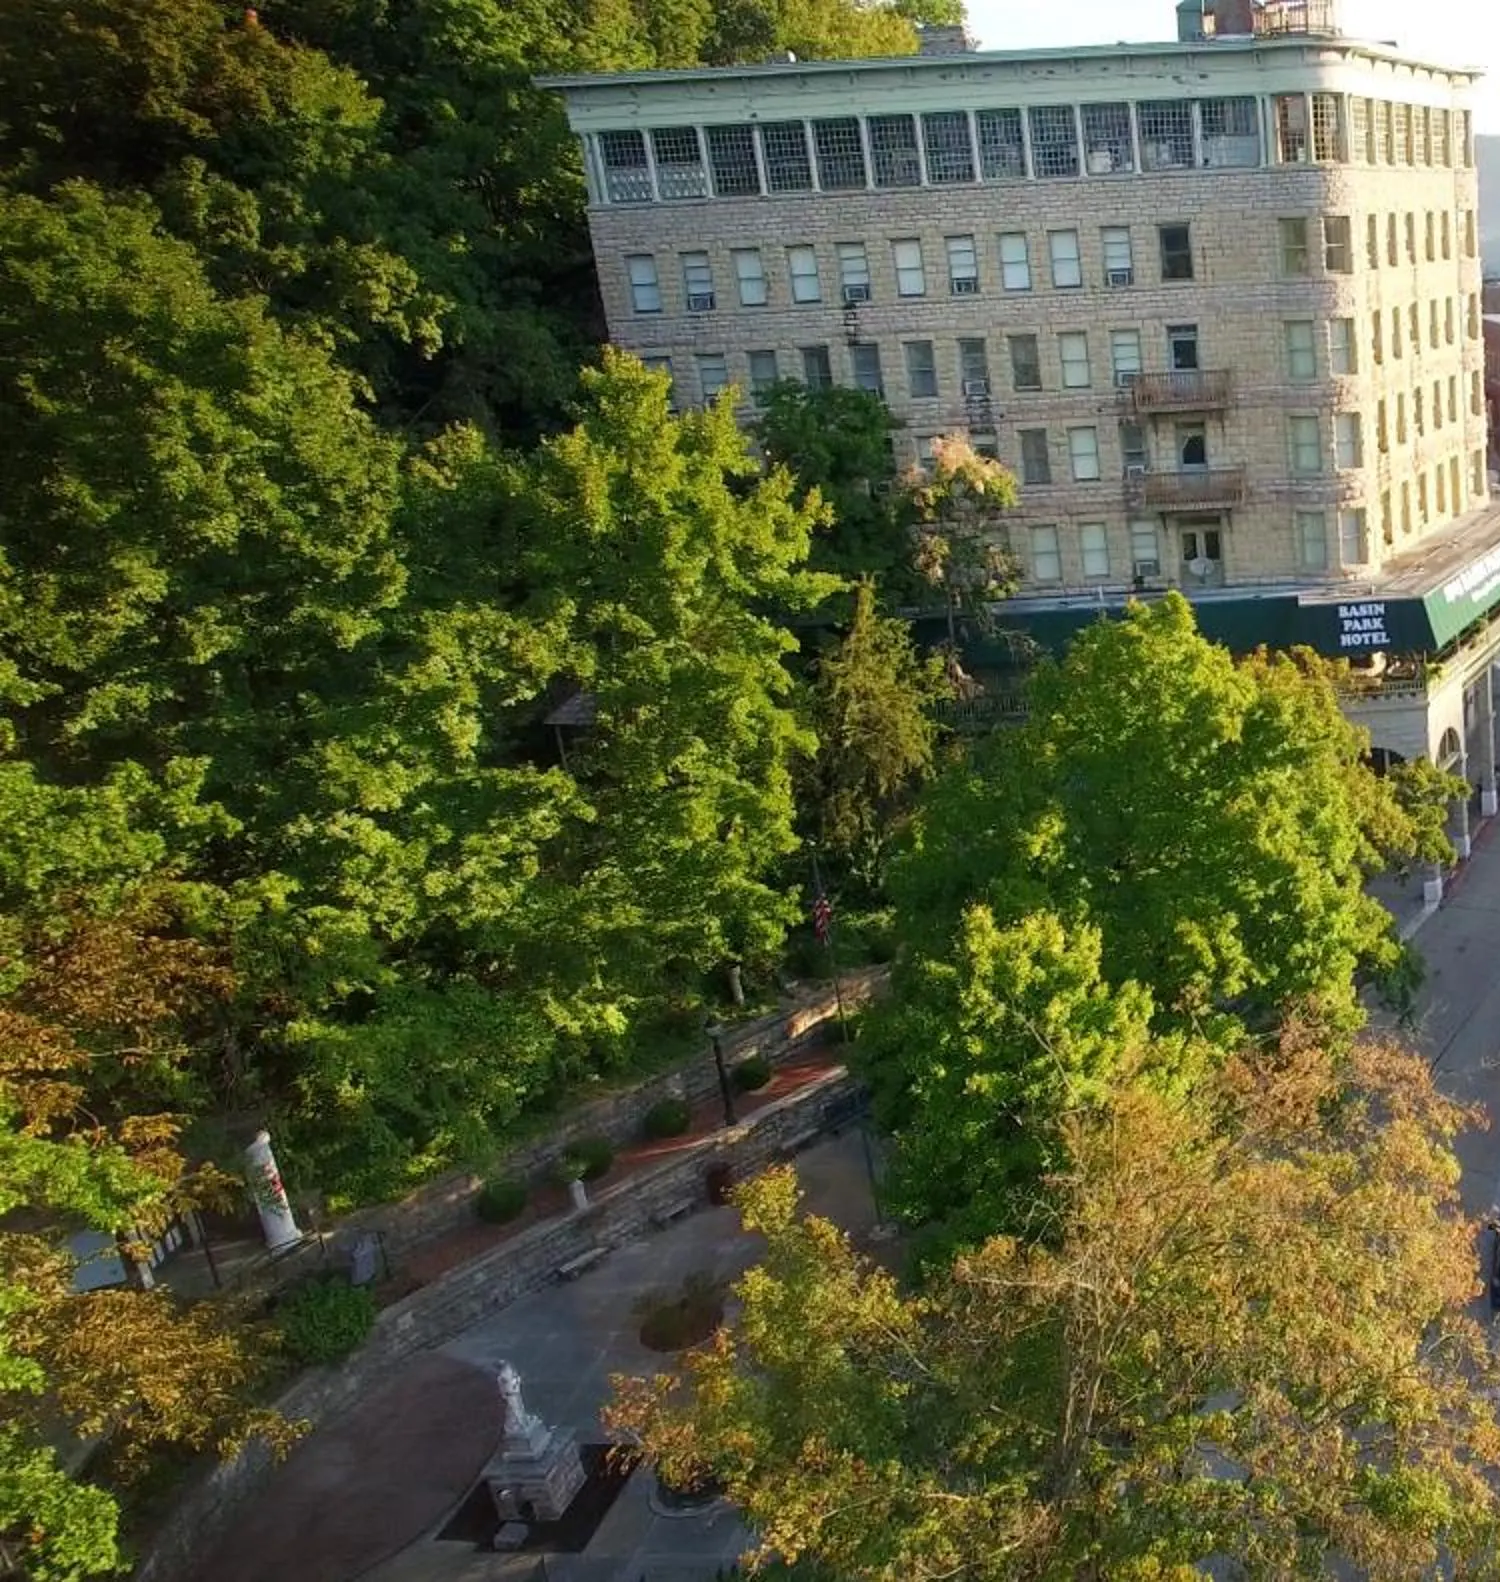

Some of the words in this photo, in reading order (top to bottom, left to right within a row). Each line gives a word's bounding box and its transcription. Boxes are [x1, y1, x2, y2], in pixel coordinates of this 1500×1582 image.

[1338, 603, 1385, 618] BASIN
[1343, 617, 1384, 631] PARK
[1340, 631, 1391, 647] HOTEL
